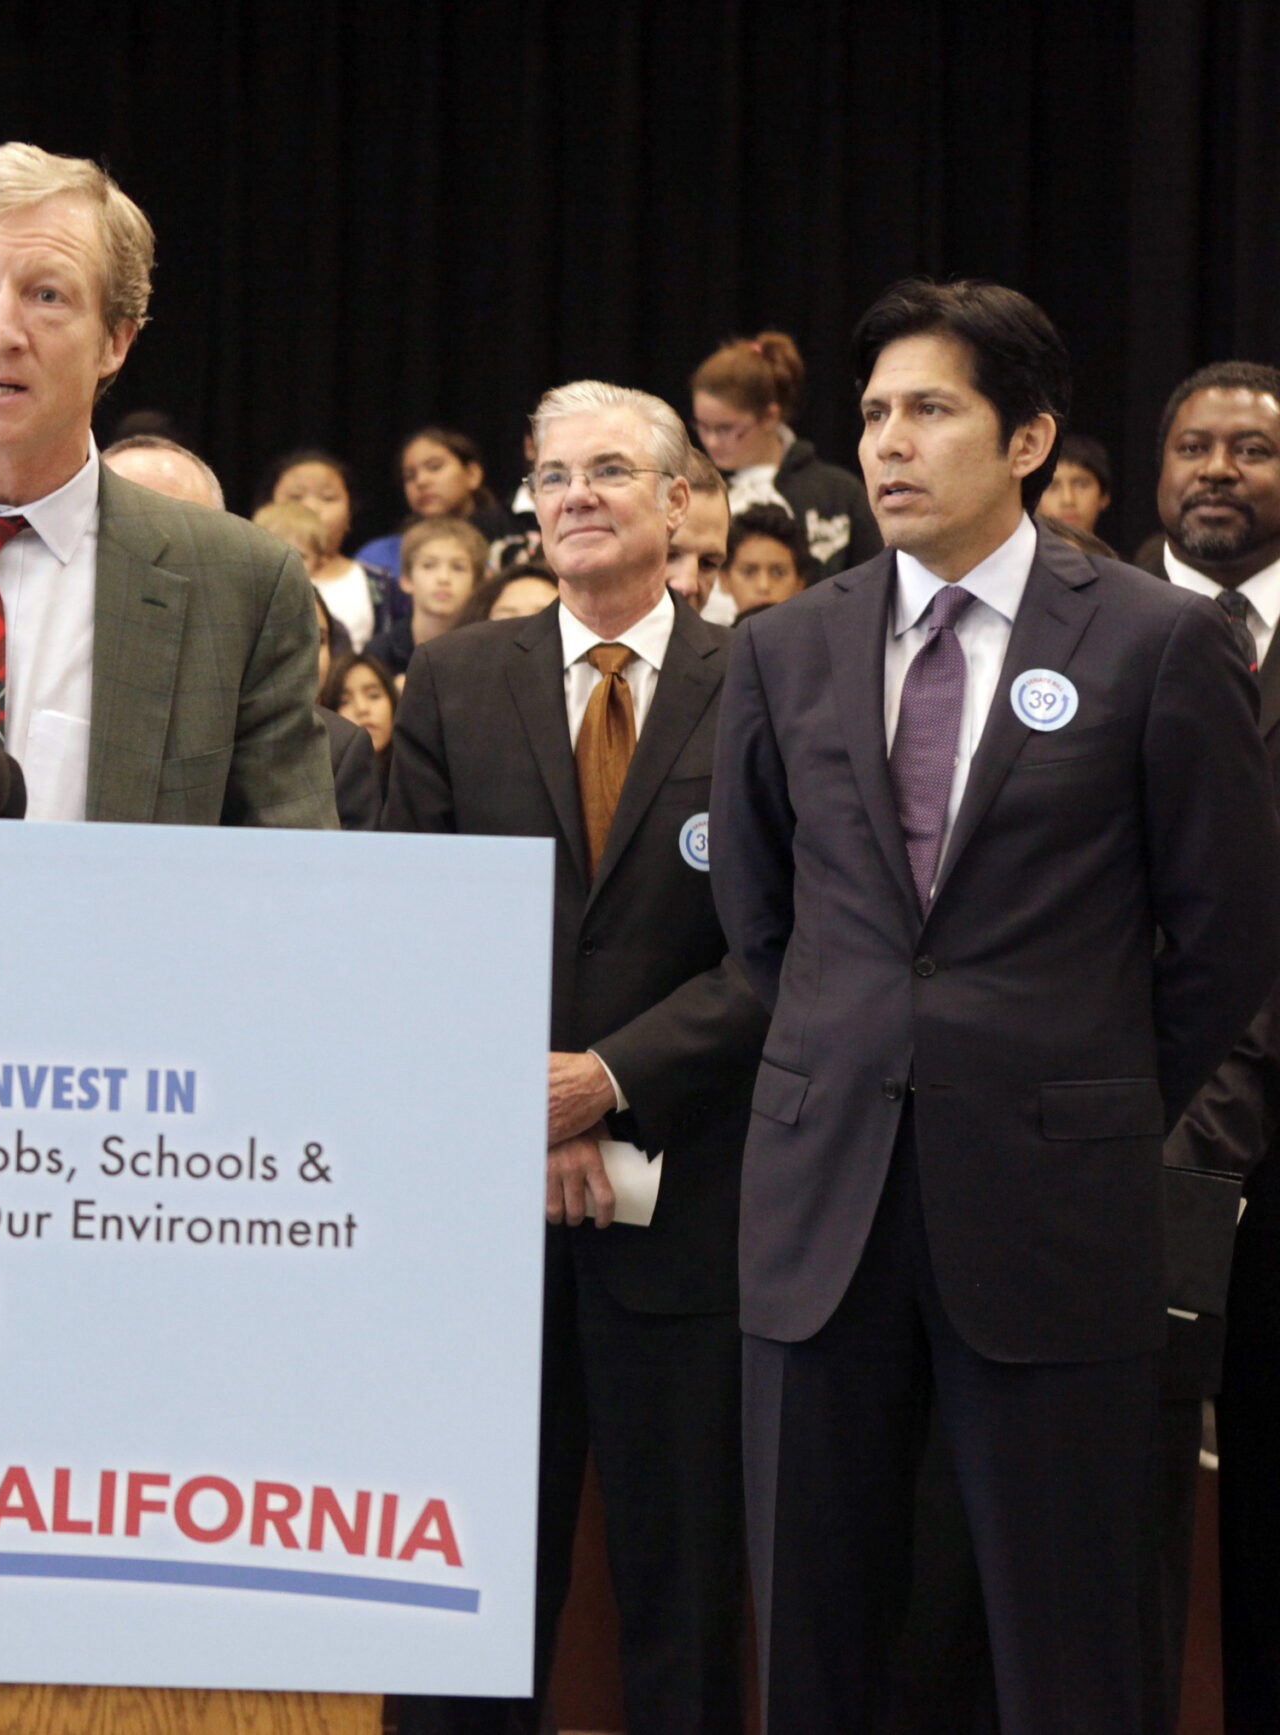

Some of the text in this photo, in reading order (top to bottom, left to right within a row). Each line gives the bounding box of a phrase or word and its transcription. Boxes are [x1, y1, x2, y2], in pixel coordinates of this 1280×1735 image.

[1028, 689, 1057, 711] 39
[145, 1069, 197, 1114] IN
[99, 1133, 279, 1183] Schools
[297, 1140, 334, 1184] &
[71, 1198, 359, 1249] Environment
